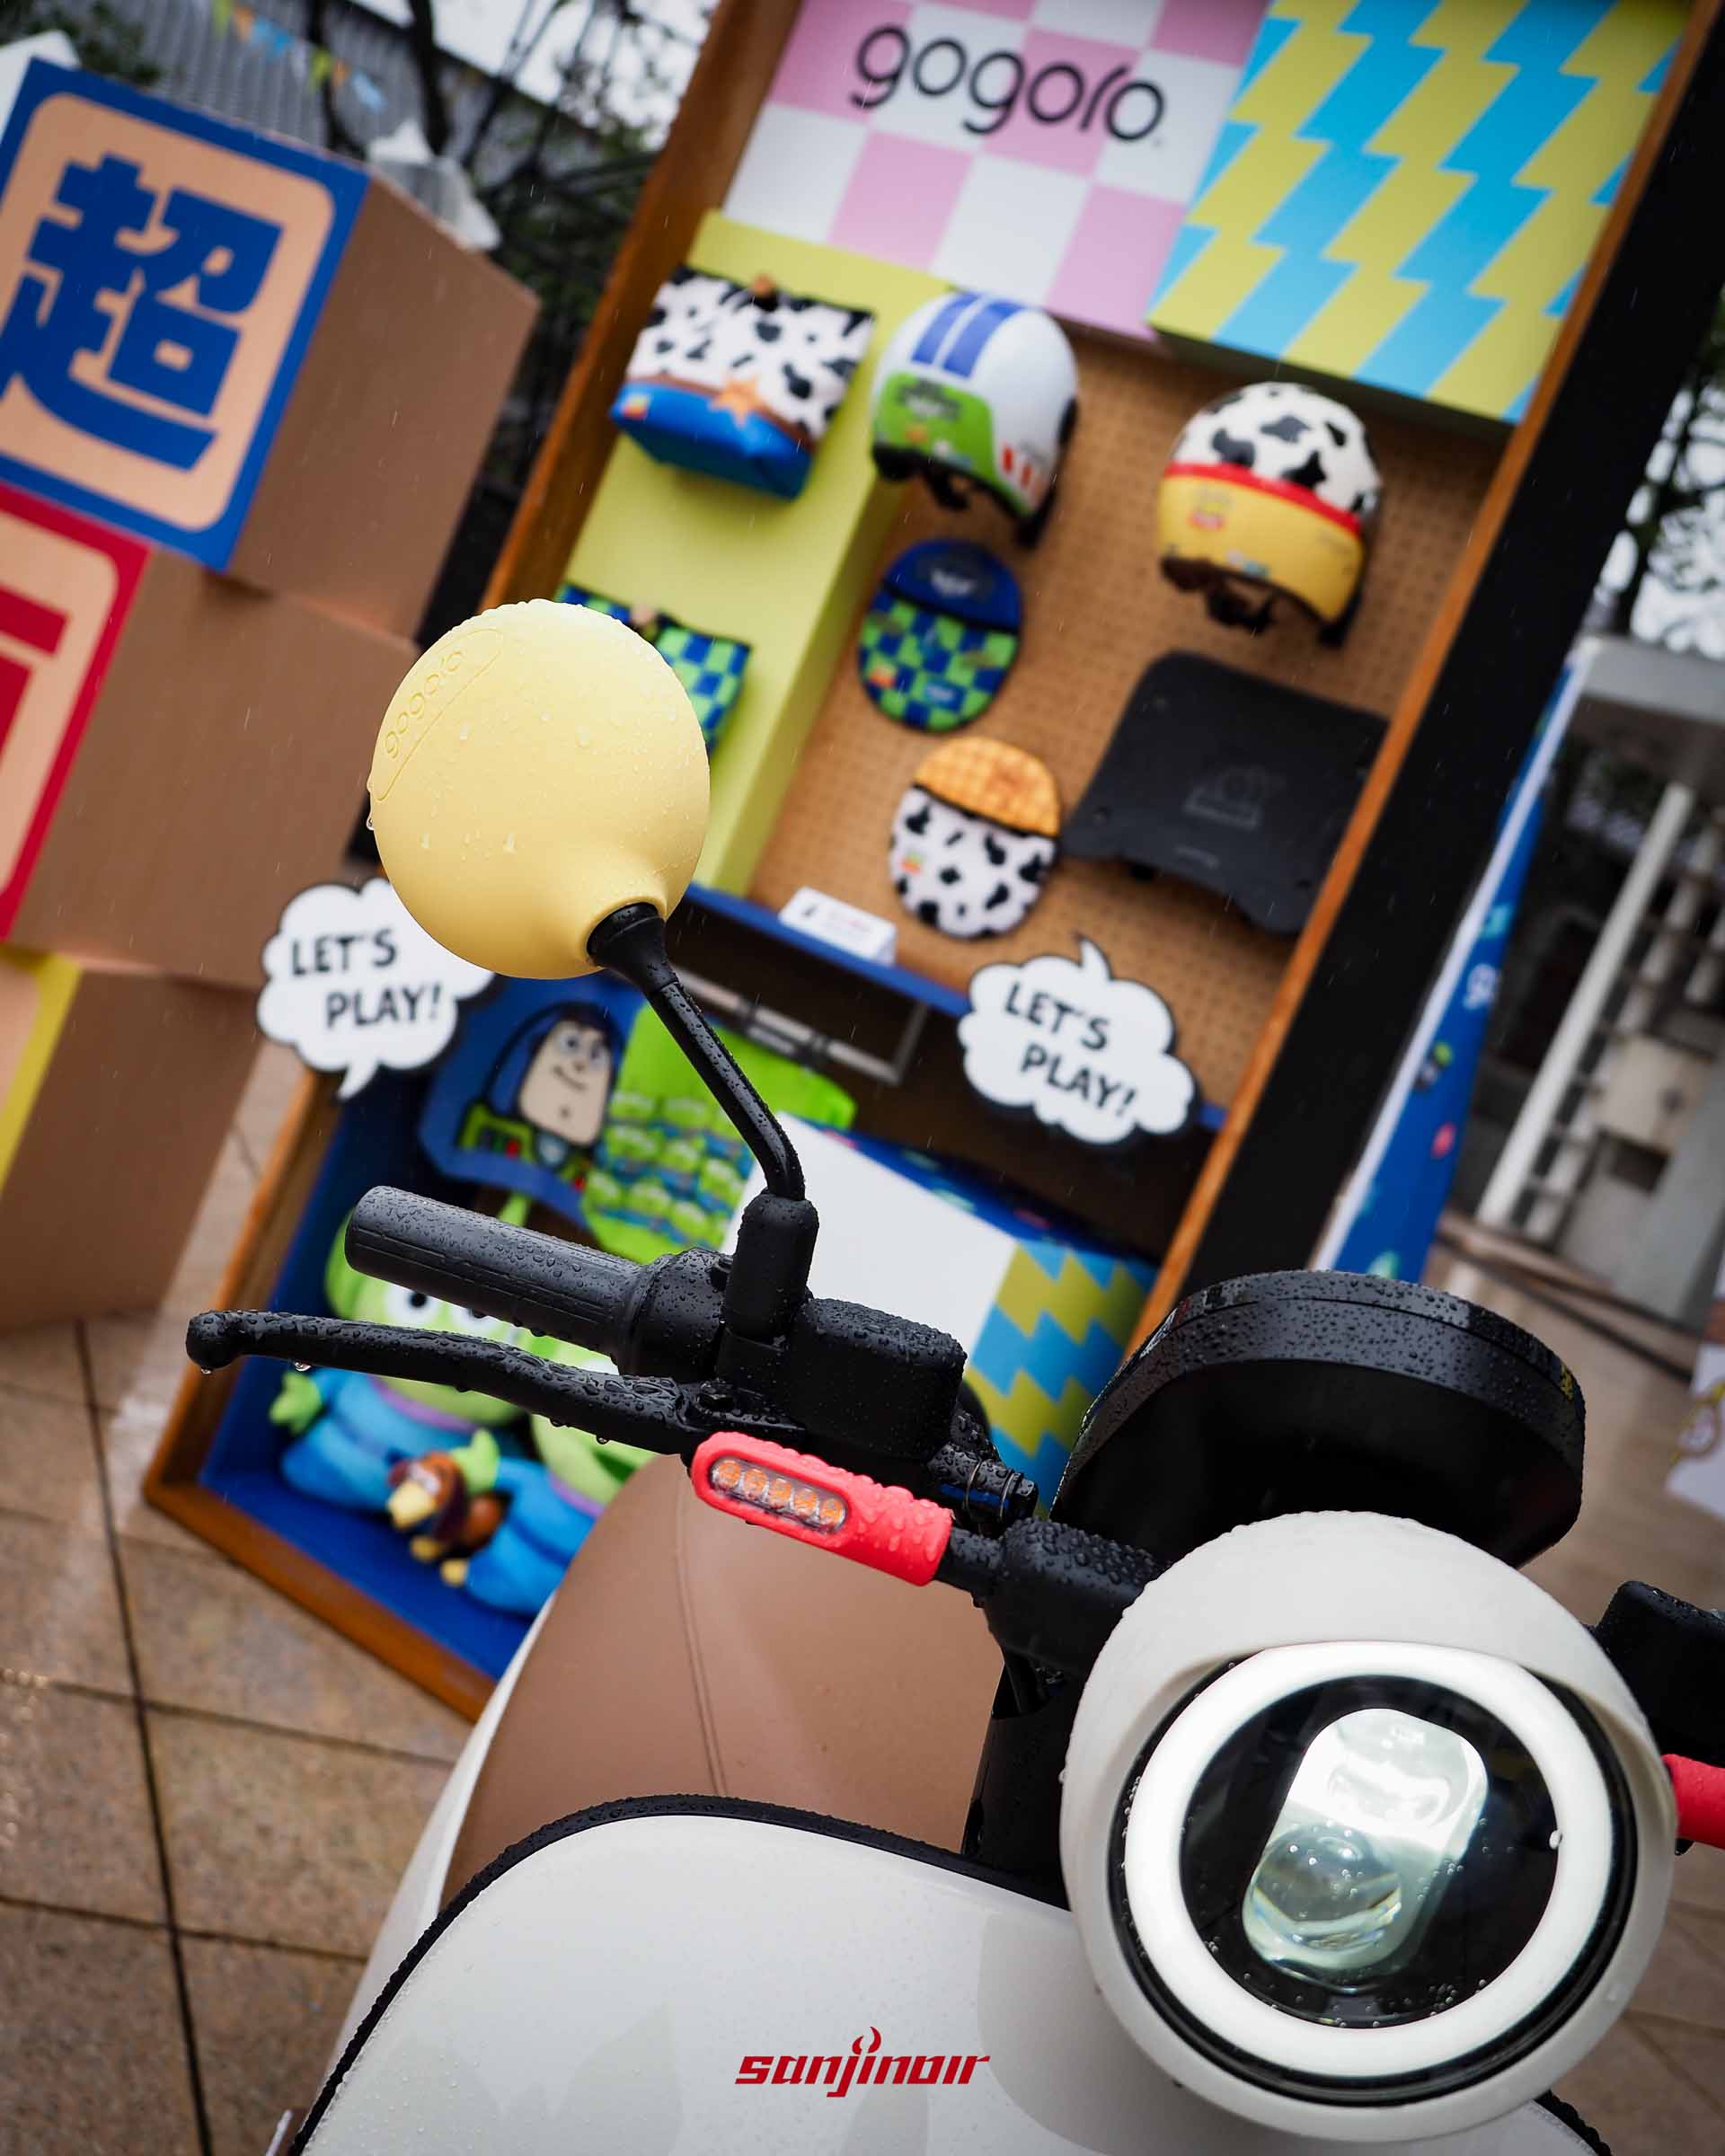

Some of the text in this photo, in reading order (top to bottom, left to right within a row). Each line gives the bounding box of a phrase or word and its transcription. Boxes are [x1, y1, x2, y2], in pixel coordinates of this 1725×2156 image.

[849, 23, 1165, 142] gogoro
[0, 152, 285, 471] 超
[383, 649, 464, 761] gogoro
[292, 928, 397, 976] LET'S
[325, 981, 442, 1029] PLAY!
[1004, 981, 1110, 1051] LET'S
[1020, 1040, 1137, 1118] PLAY!
